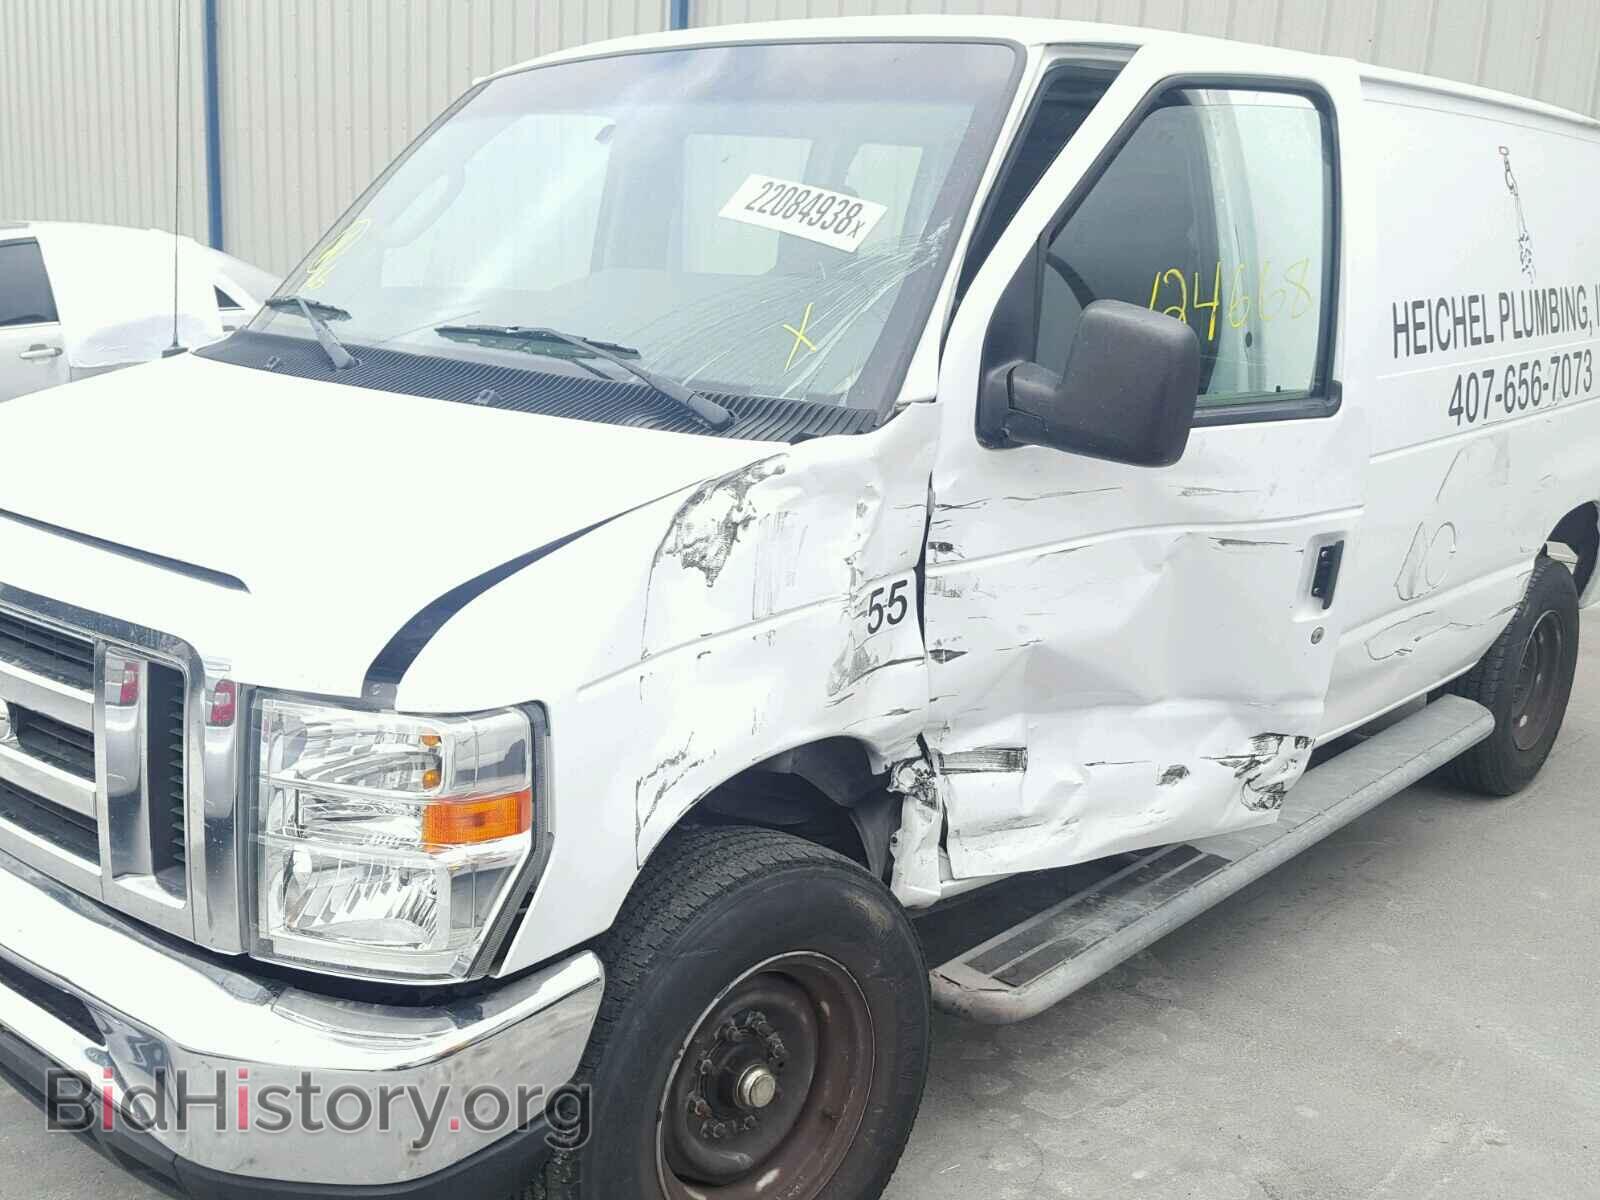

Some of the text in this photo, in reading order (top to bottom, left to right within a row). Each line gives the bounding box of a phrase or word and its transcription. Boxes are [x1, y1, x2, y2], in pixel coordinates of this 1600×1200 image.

[1392, 294, 1494, 358] HEICHEL
[1498, 284, 1593, 342] PLUMBING,
[1448, 349, 1593, 426] 407-656-7073
[867, 579, 908, 634] 55
